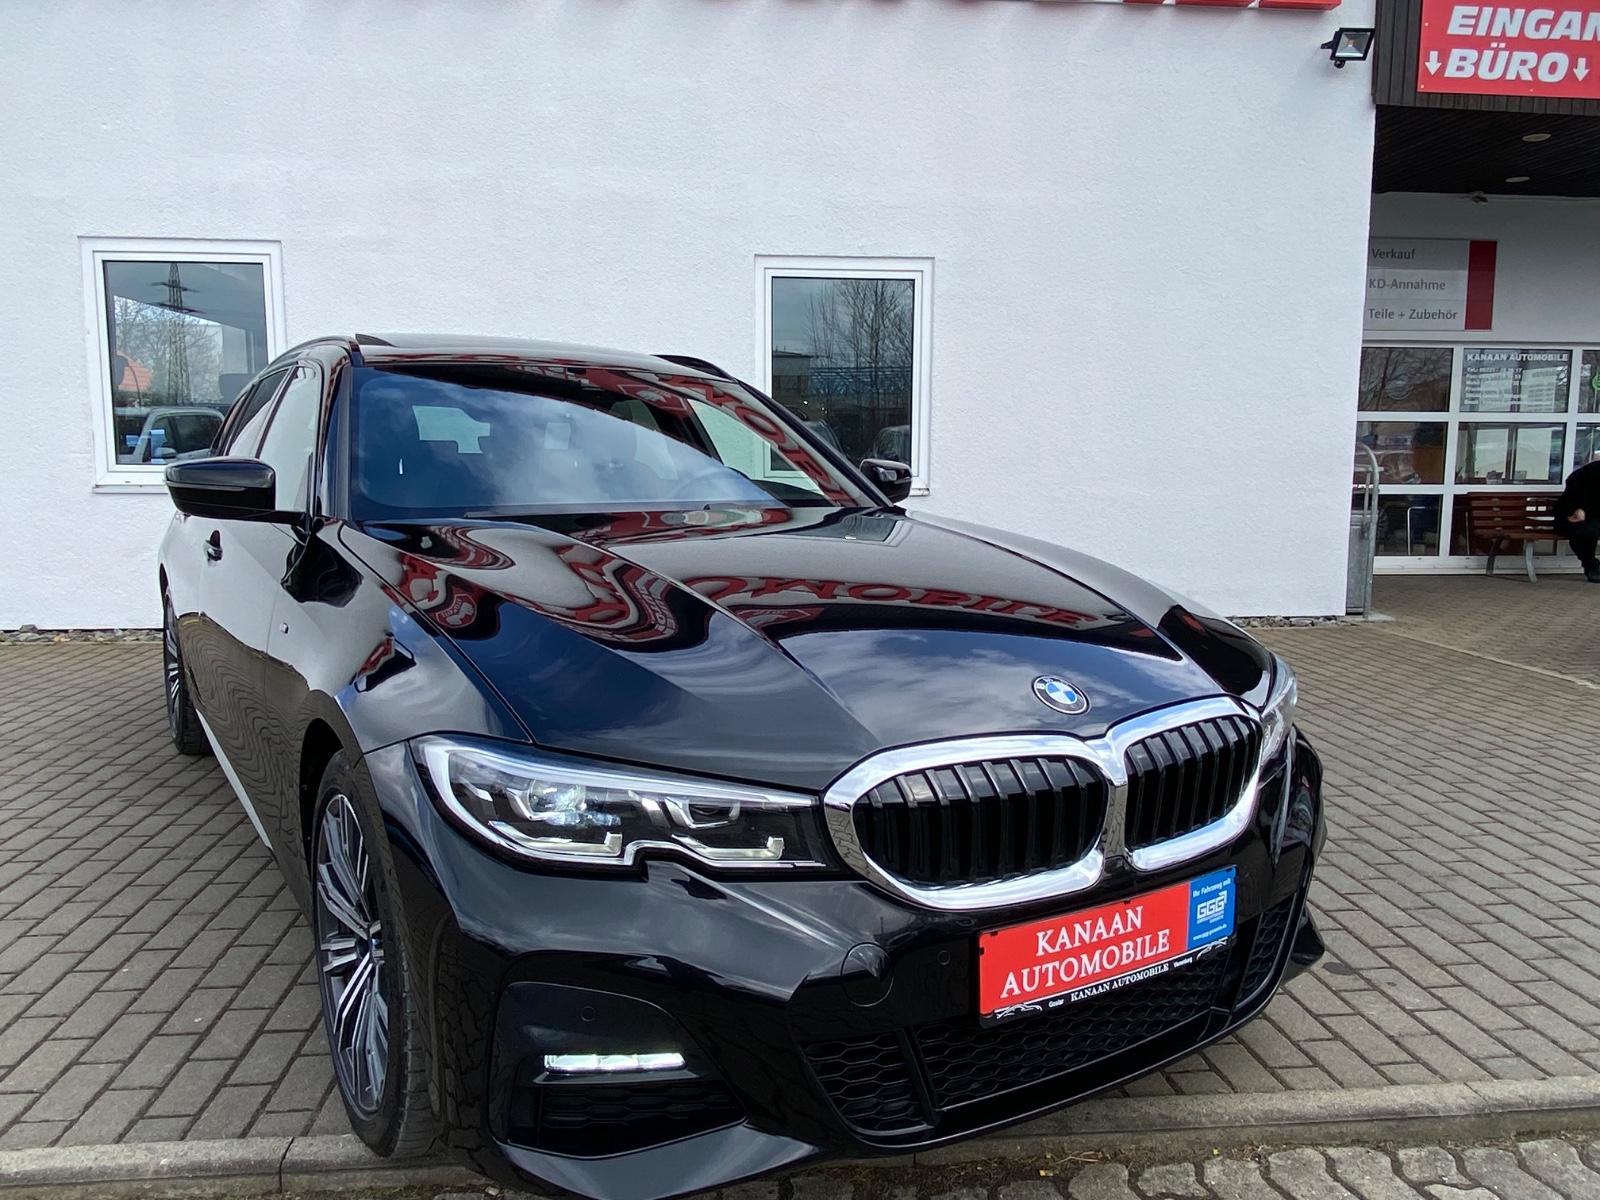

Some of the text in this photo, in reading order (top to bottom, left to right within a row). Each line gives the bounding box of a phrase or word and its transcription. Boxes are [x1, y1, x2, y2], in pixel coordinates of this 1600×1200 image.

[1444, 42, 1569, 83] BÜRO
[1371, 248, 1416, 260] Verkauf
[1368, 278, 1446, 291] KD-Annahme
[1368, 309, 1395, 320] Teile
[1408, 308, 1458, 320] Zubehör
[1467, 353, 1569, 362] KANAAN AUTOMOBILE
[1197, 894, 1226, 919] GGG
[1036, 906, 1143, 957] KANAAN
[1000, 929, 1170, 998] AUTOMOBILE
[1070, 982, 1110, 1002] KANAAN
[1111, 963, 1169, 989] AUTOMOBILE
